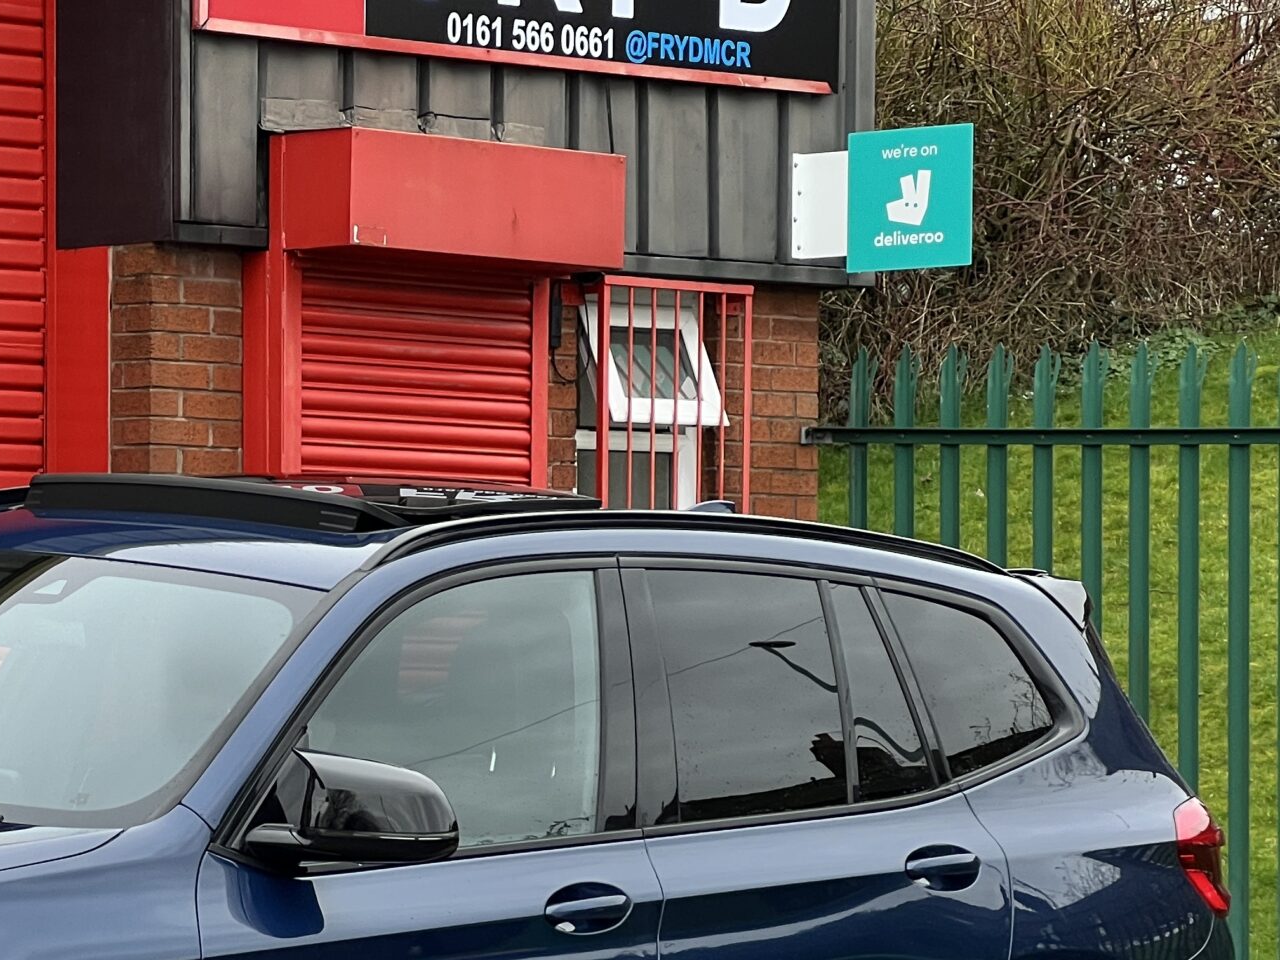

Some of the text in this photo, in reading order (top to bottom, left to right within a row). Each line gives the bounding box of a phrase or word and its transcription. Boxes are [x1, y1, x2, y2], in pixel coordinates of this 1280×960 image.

[447, 12, 502, 47] 0161
[512, 19, 554, 53] 566
[561, 24, 614, 59] 0661
[625, 30, 751, 68] @FRYDMCR
[881, 144, 938, 159] we're on
[874, 230, 944, 247] deliveroo
